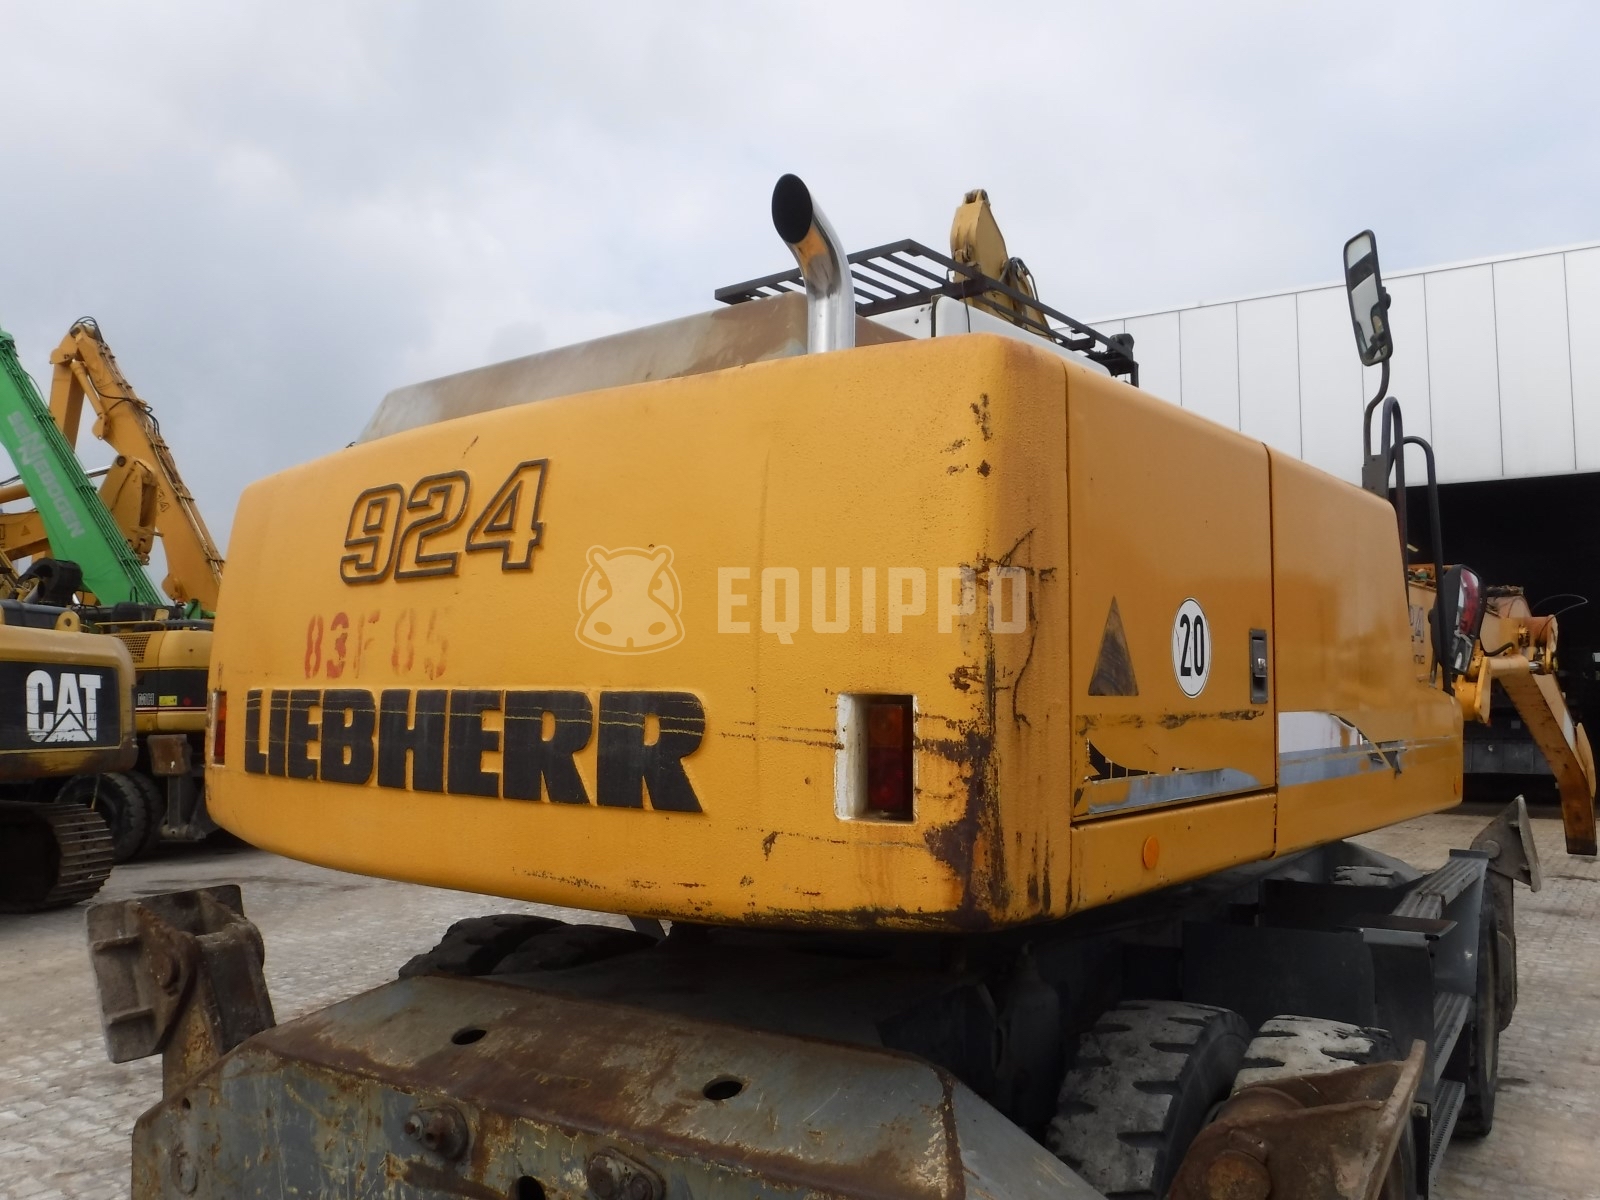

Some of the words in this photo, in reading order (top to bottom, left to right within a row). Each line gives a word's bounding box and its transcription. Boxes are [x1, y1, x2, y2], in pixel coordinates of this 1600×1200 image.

[7, 411, 86, 539] SENNEBOGEN
[340, 458, 549, 586] 924
[26, 669, 102, 742] CAT
[1179, 613, 1205, 677] 20
[245, 688, 707, 813] LIEBHERR
